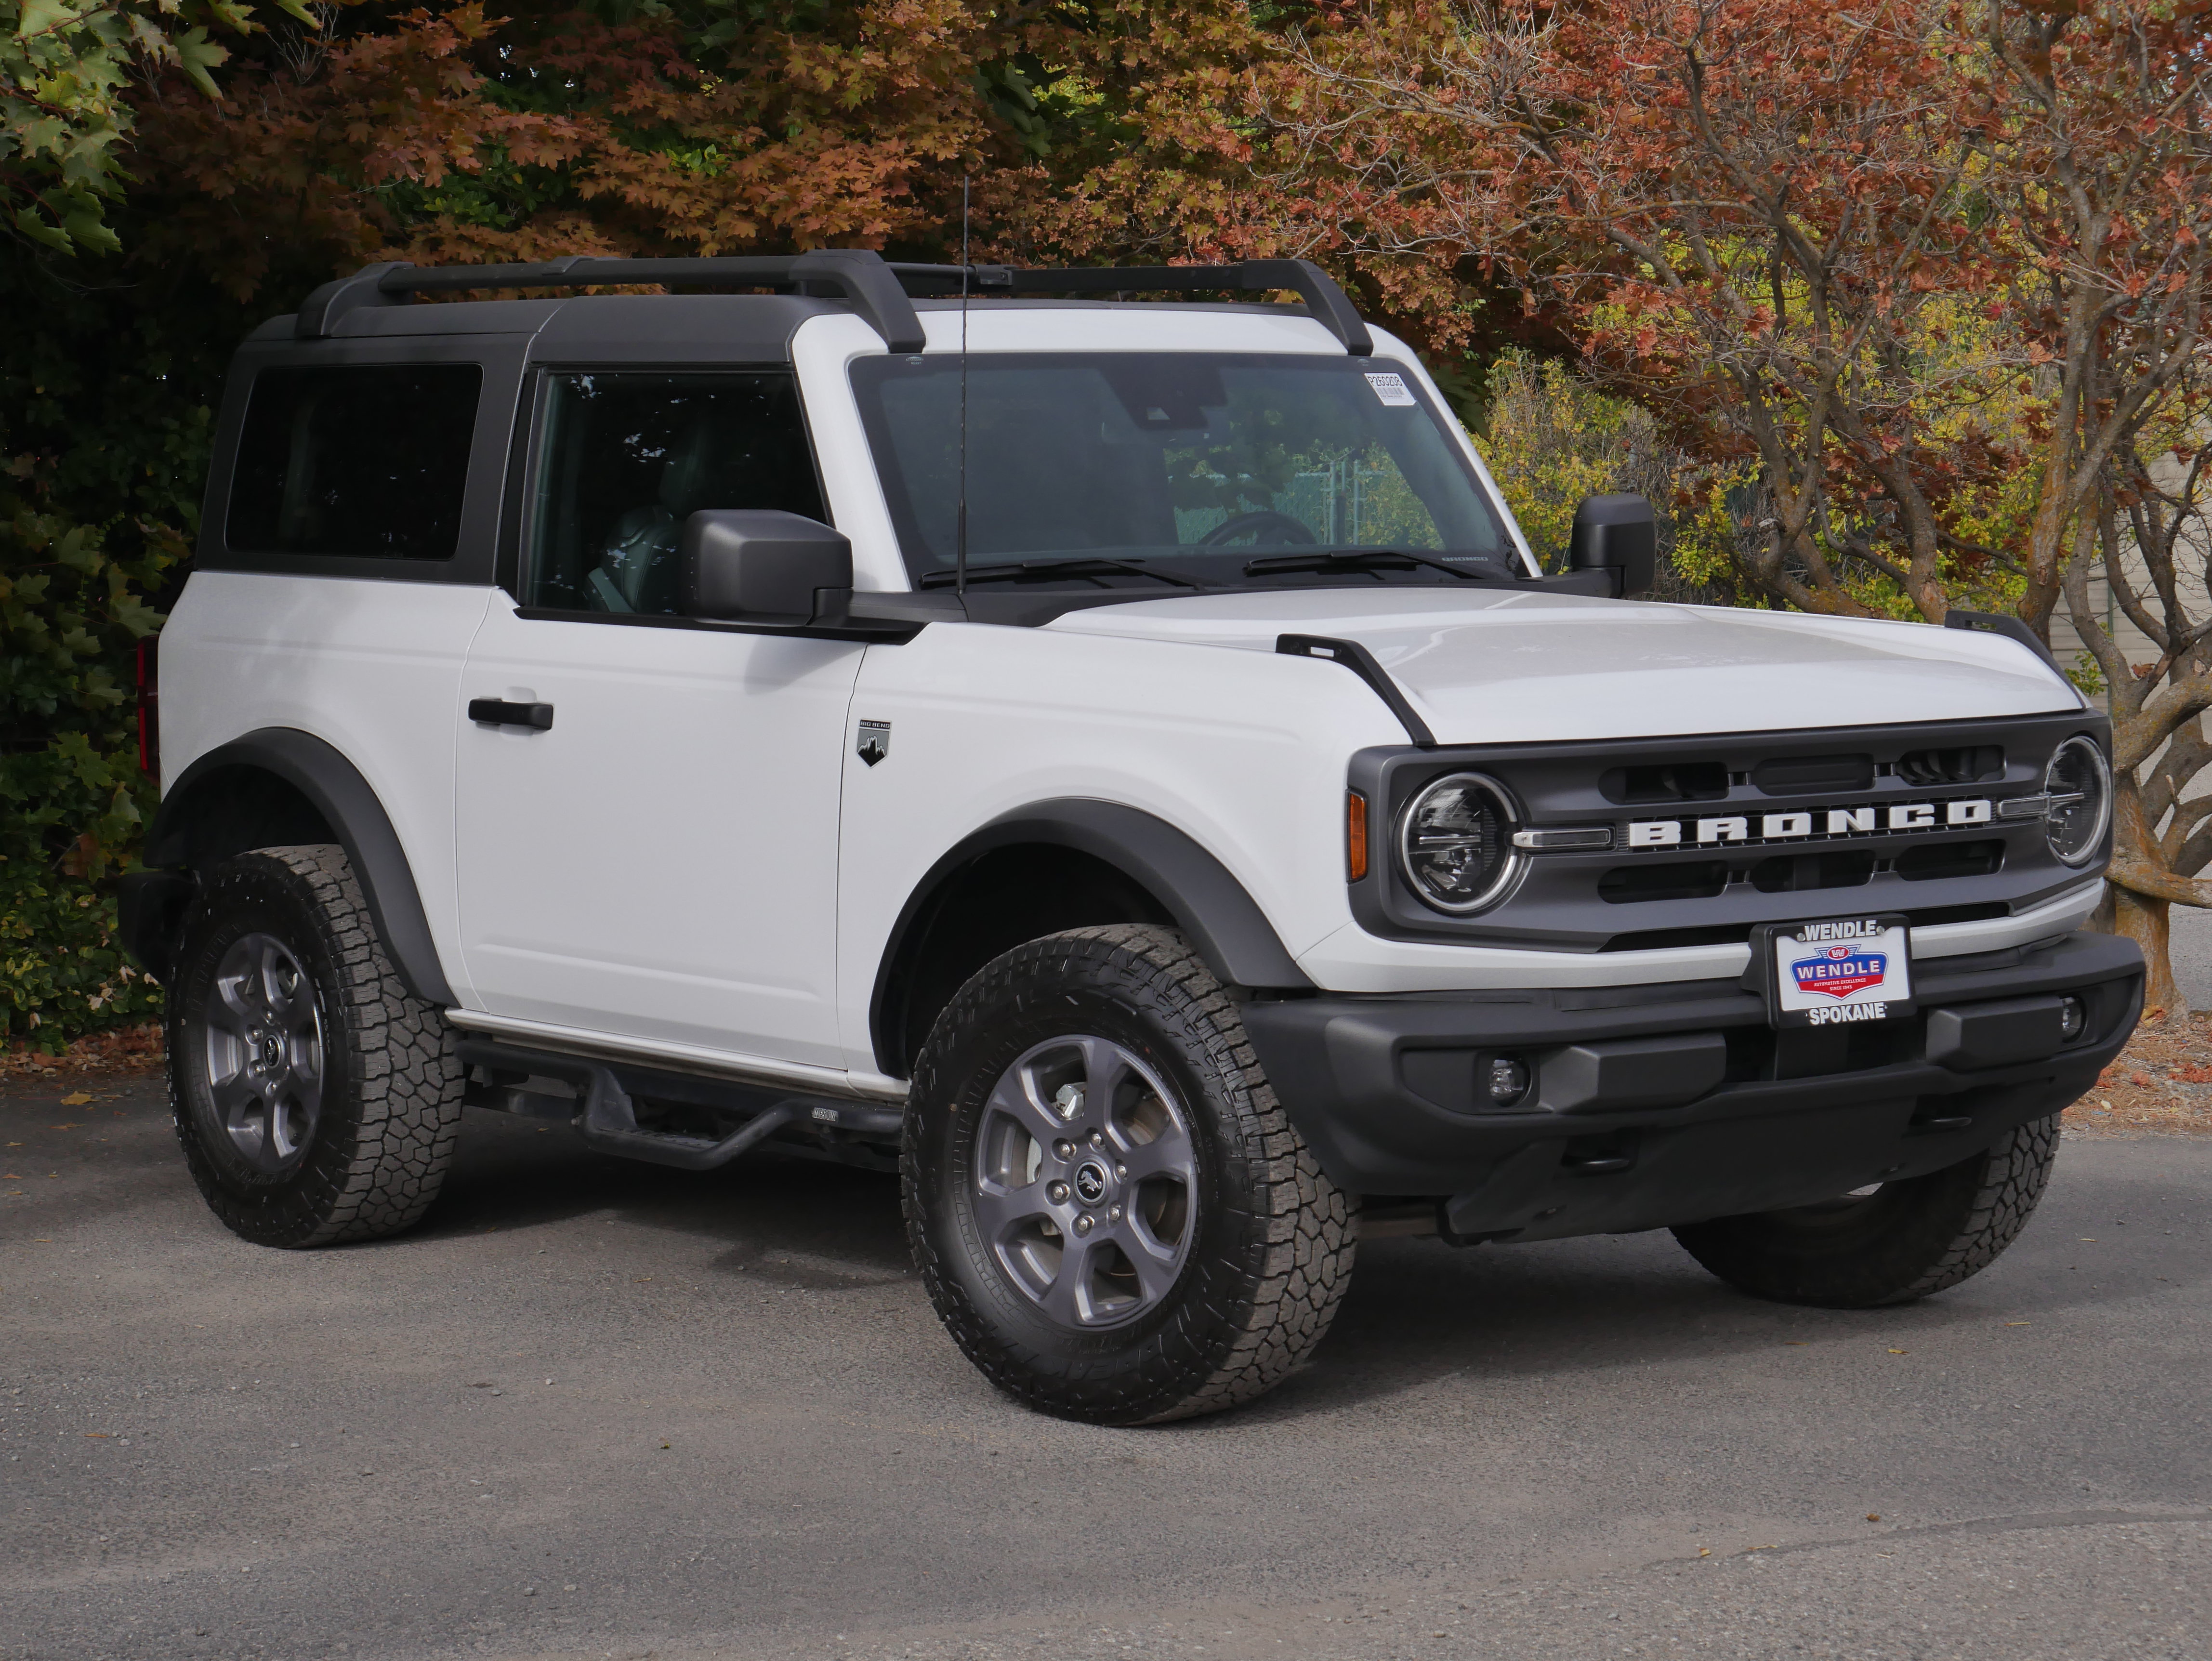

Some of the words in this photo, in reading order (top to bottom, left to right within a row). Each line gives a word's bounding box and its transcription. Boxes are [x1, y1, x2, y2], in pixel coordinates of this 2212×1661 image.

[1368, 376, 1403, 386] P260208
[1629, 799, 1991, 847] BRONCO
[1804, 920, 1877, 941] WENDLE
[1797, 961, 1880, 979] WENDLE
[1810, 1002, 1886, 1025] SPOKANE
